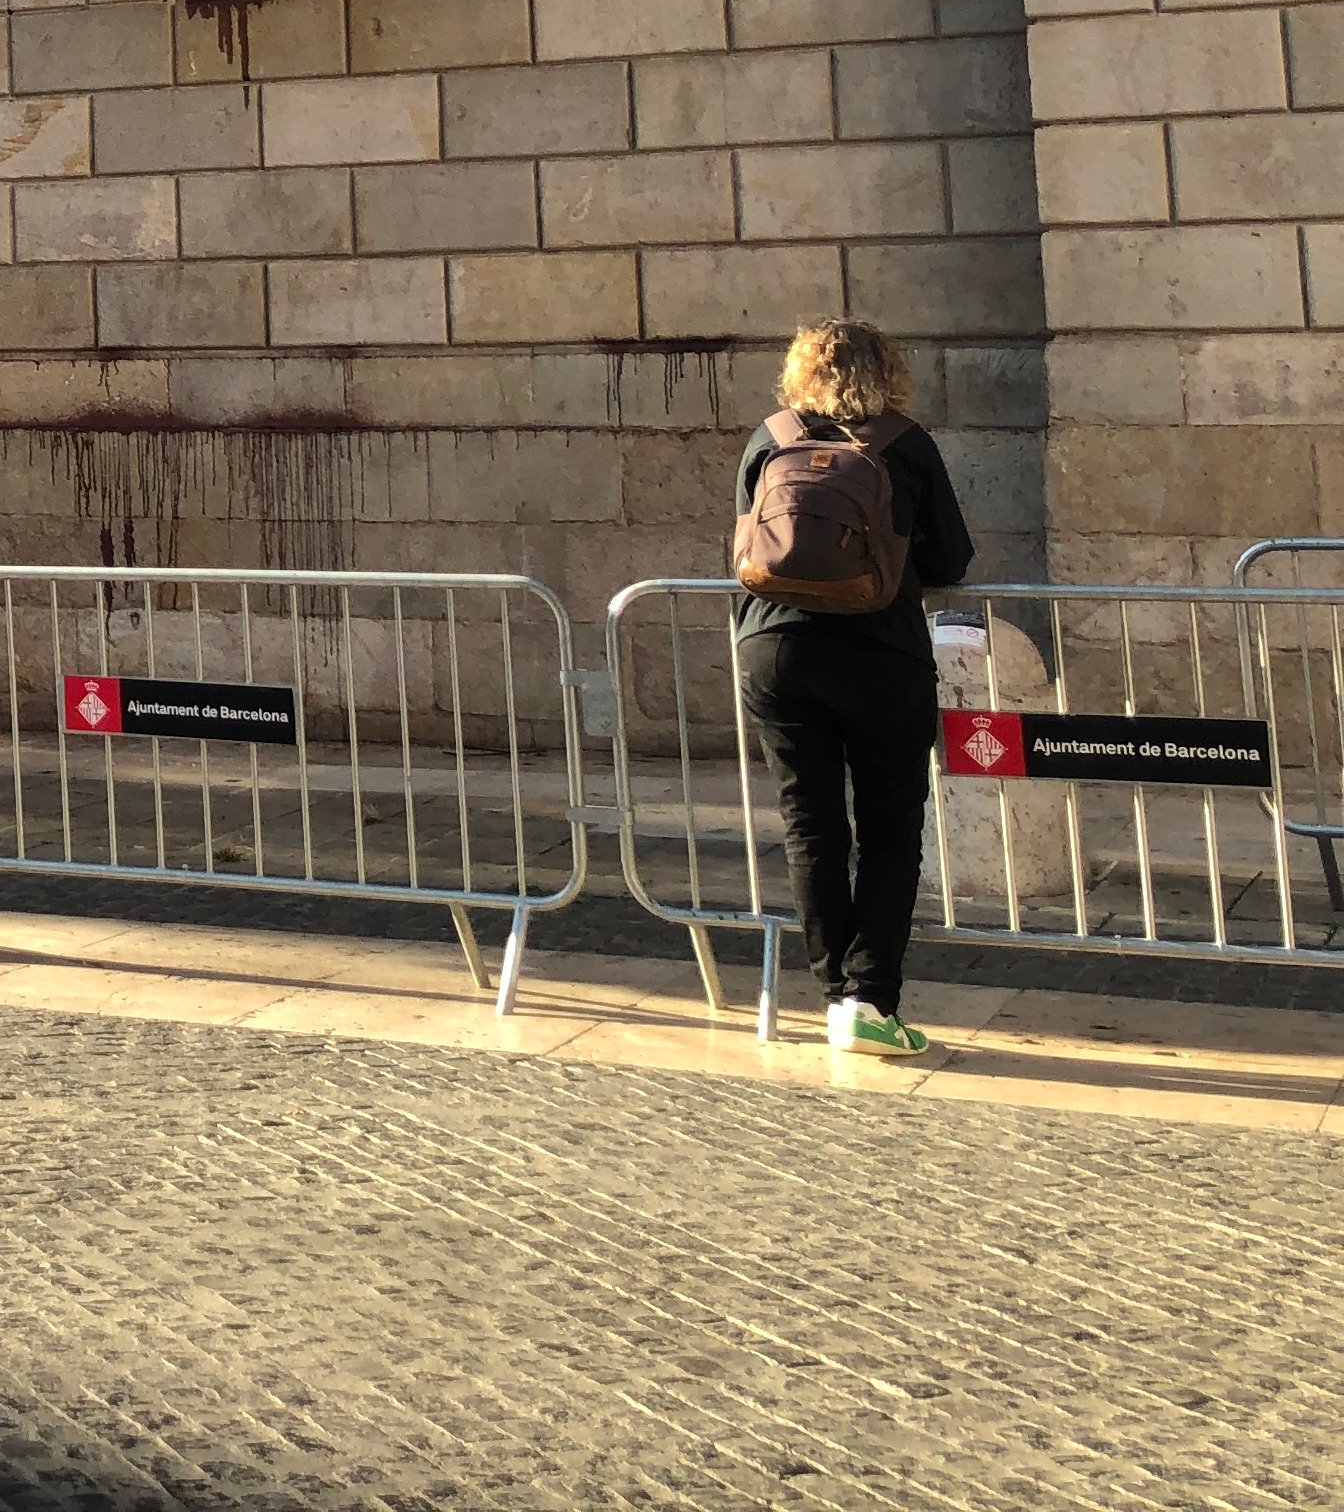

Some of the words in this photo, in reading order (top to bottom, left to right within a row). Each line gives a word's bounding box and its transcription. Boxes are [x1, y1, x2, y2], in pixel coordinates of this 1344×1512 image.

[127, 699, 199, 717] Ajuntament
[202, 706, 218, 718] de
[220, 706, 289, 724] Barcelona
[1033, 737, 1135, 758] Ajuntament
[1139, 741, 1161, 757] de
[1165, 742, 1261, 762] Barcelona
